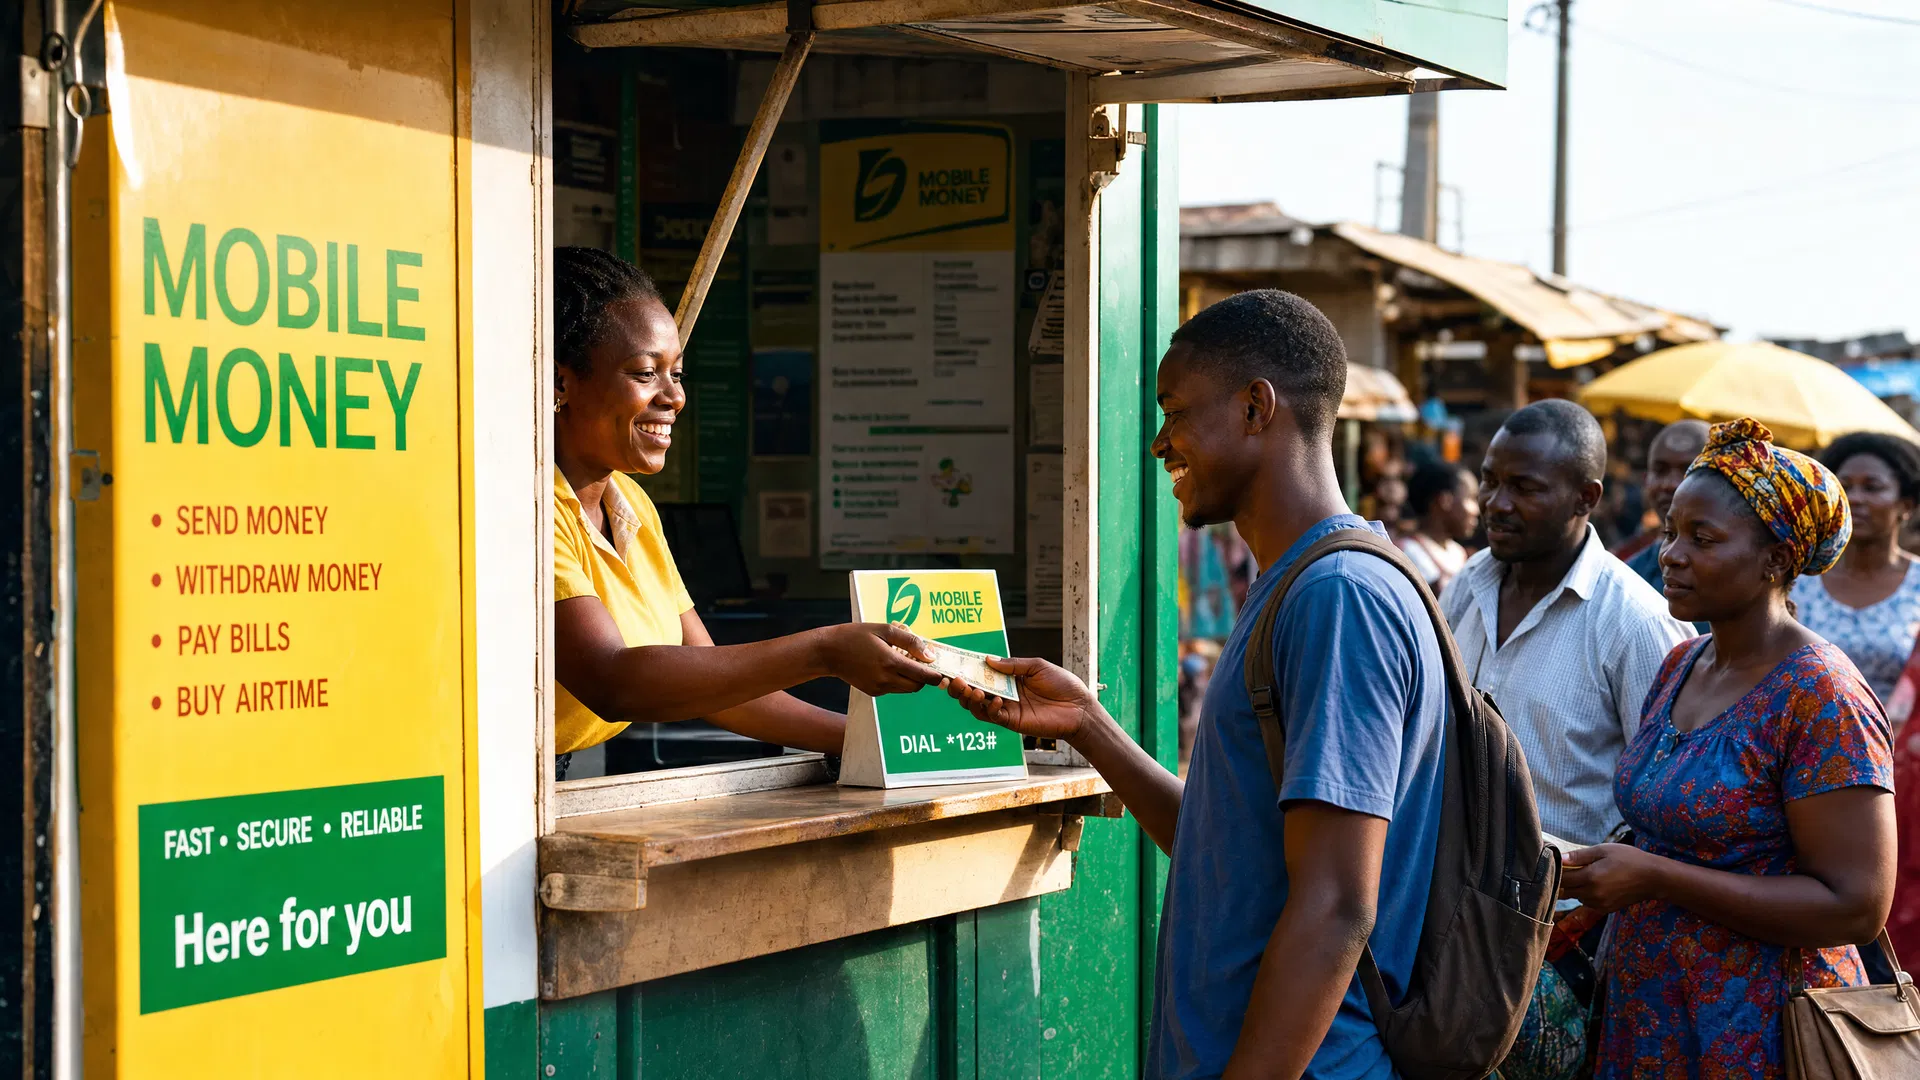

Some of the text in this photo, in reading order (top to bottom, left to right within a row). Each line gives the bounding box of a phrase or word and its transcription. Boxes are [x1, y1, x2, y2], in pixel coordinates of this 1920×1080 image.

[918, 168, 990, 188] MOBILE
[919, 187, 989, 206] MONEY
[143, 217, 426, 342] MOBILE
[144, 342, 423, 452] MONEY
[176, 505, 328, 536] SEND MONEY
[176, 562, 383, 595] WITHDRAW MONEY
[929, 590, 983, 607] MOBILE
[931, 607, 983, 624] MONEY
[178, 621, 290, 656] PAY BILLS
[177, 678, 329, 717] BUY AIRTIME
[899, 733, 942, 754] DIAL
[164, 804, 423, 860] FAST SECURE RELIABLE
[174, 894, 412, 969] Here for you
